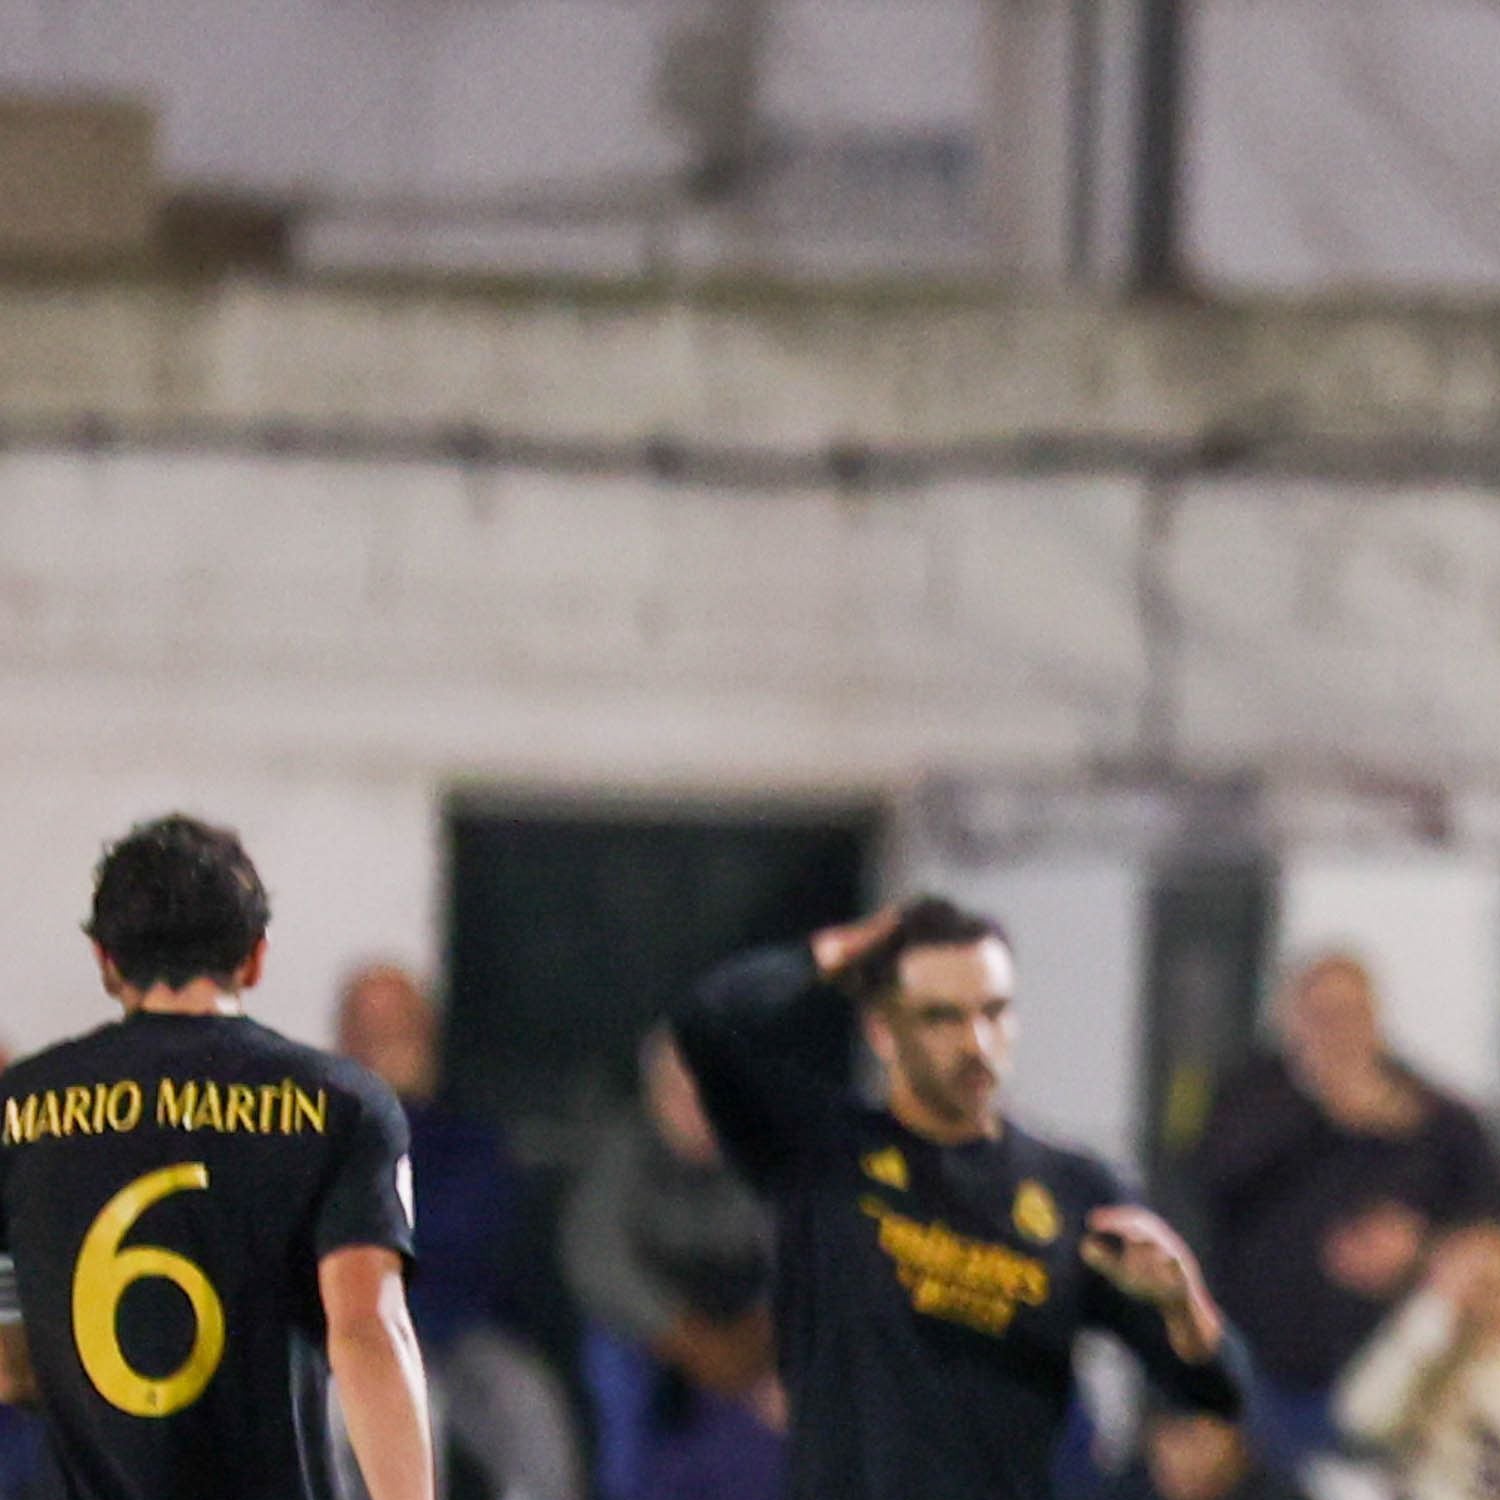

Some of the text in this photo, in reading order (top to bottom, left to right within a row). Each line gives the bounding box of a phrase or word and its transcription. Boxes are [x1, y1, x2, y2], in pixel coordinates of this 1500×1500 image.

[3, 1076, 326, 1145] MARIO MARTÍN
[72, 1162, 226, 1418] 6
